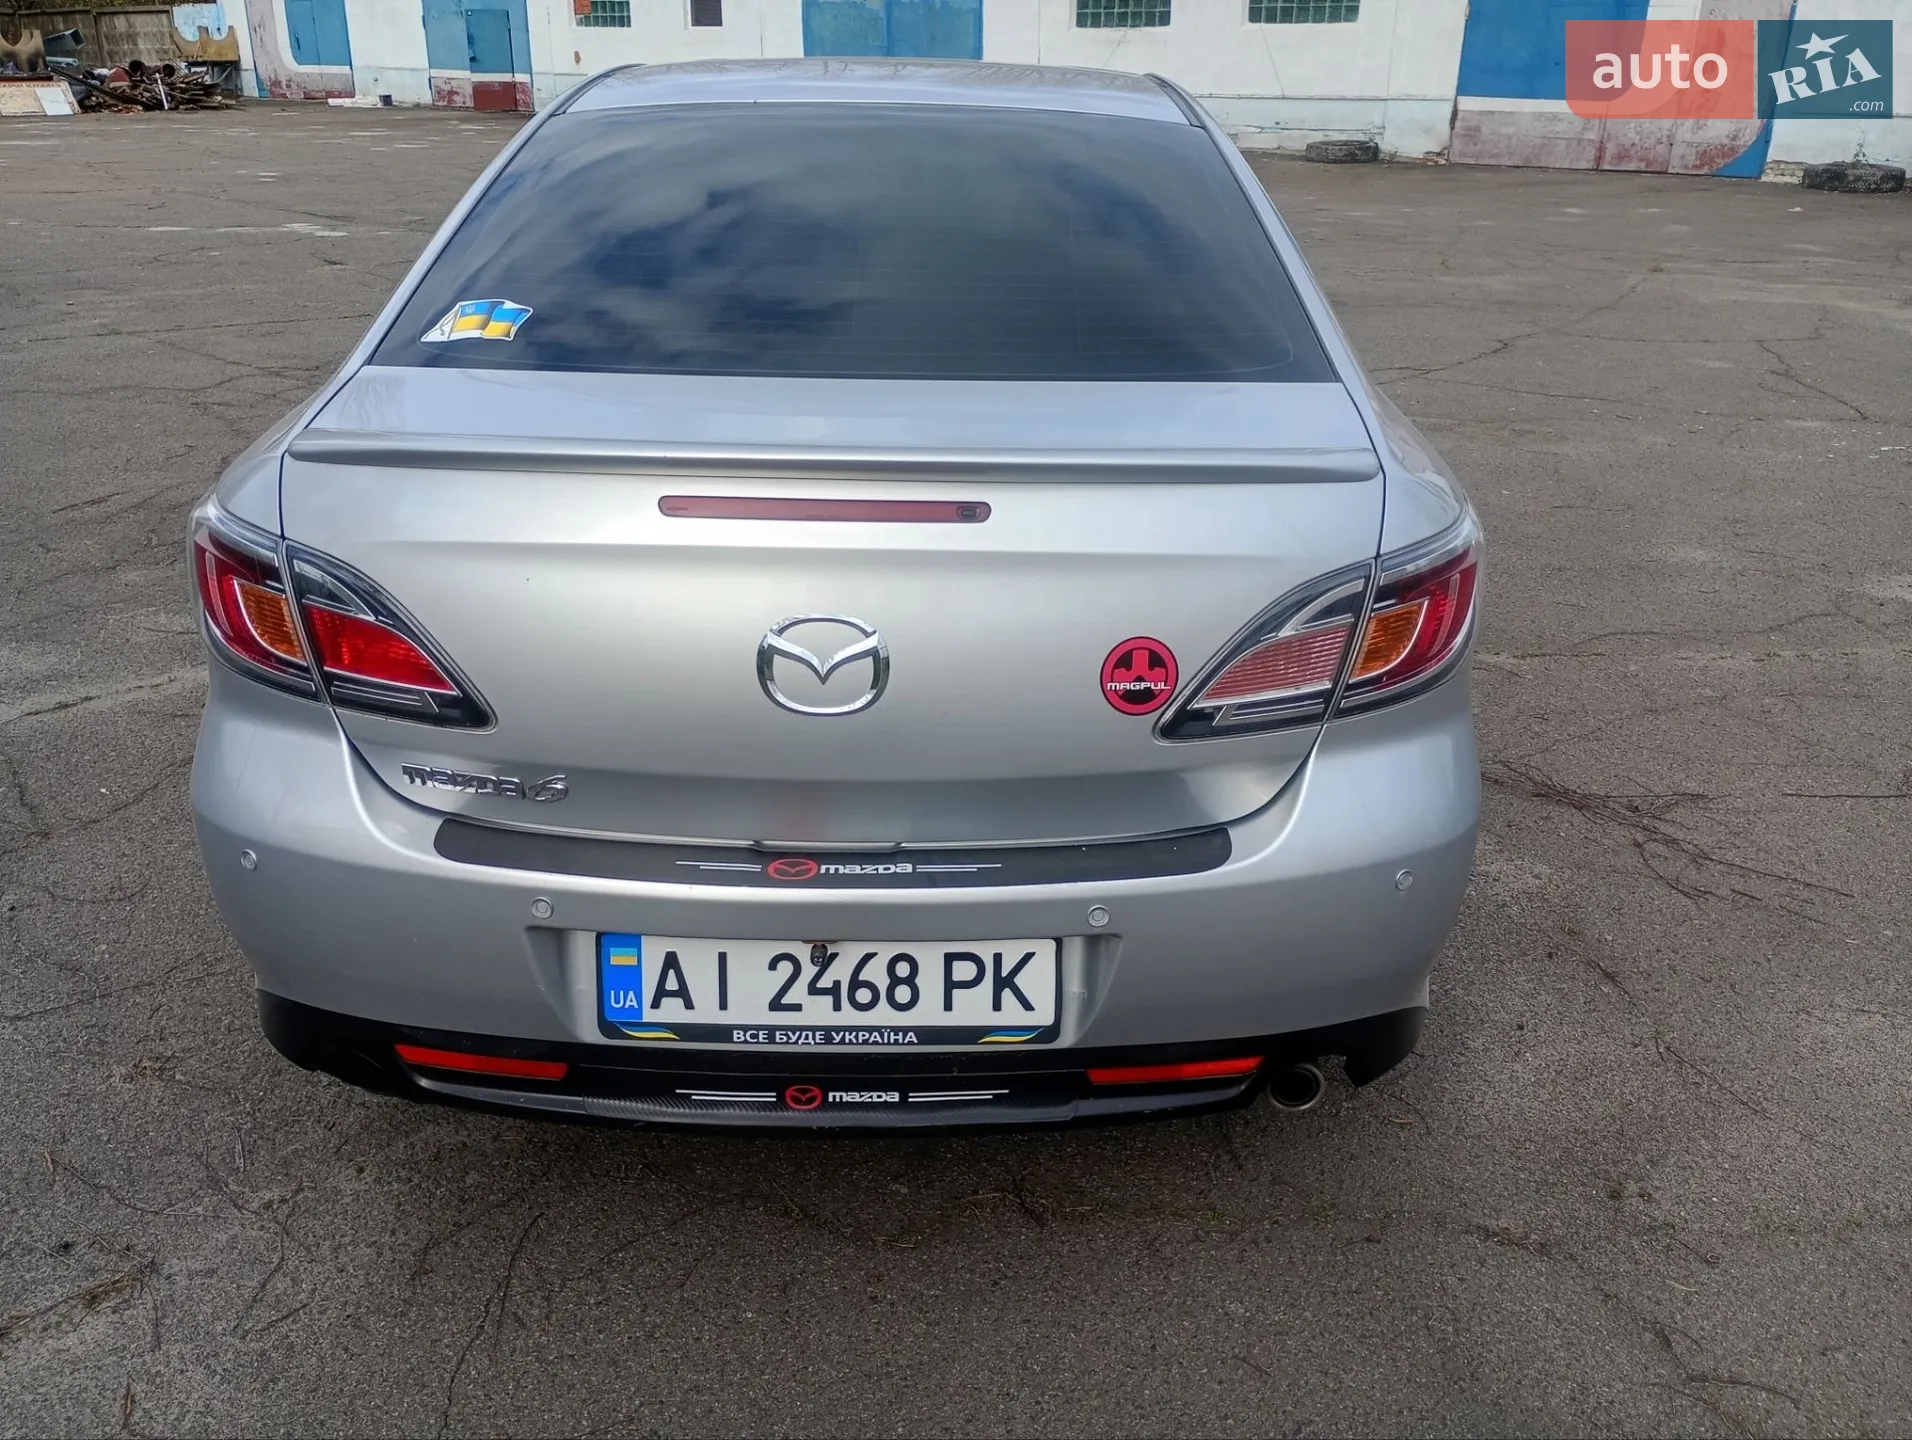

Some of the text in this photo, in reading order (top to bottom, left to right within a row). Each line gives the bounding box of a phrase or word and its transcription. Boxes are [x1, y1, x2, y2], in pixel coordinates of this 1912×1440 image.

[1107, 681, 1171, 690] MAGPUL
[820, 863, 913, 875] mazda
[768, 952, 920, 1012] 2468
[943, 951, 1037, 1012] PK
[610, 990, 639, 1009] UA
[733, 1028, 918, 1046] ВСЕ БУДЕ УКРАЇНА
[828, 1091, 900, 1102] mazda
